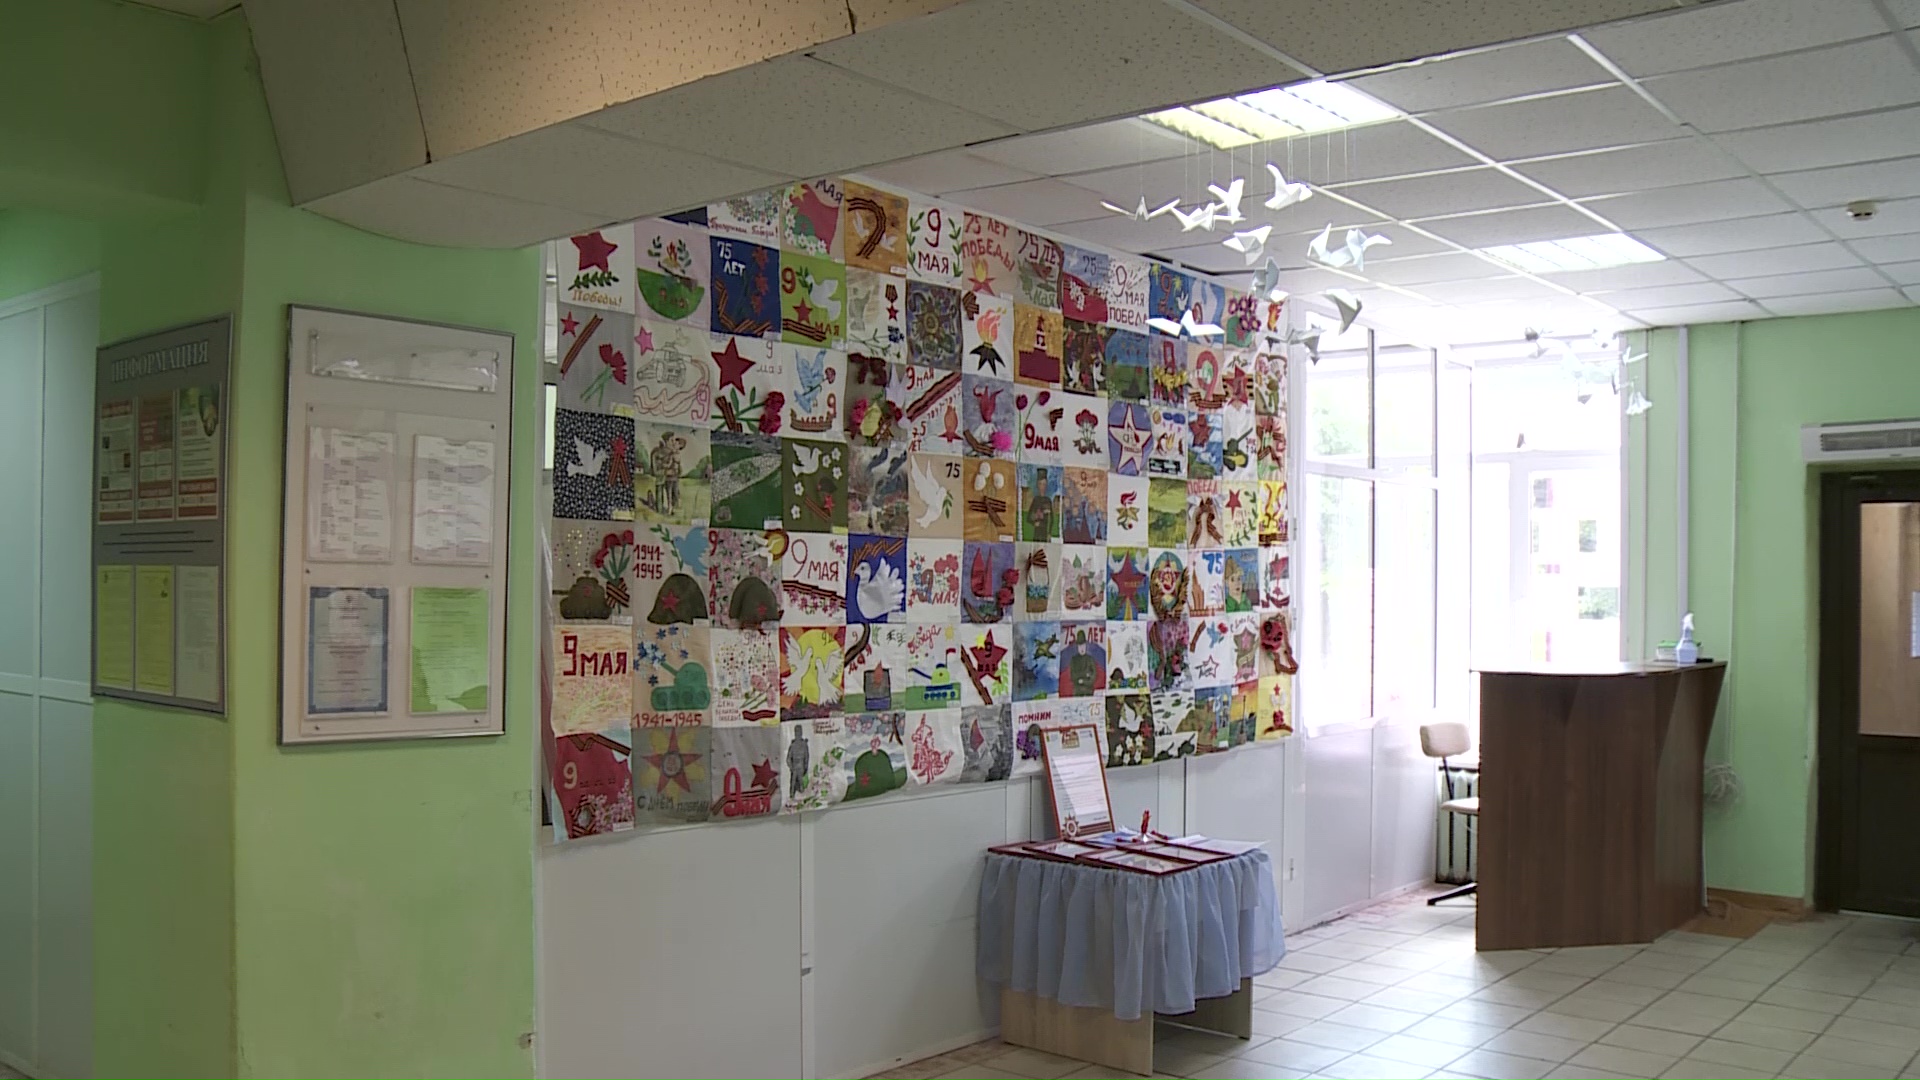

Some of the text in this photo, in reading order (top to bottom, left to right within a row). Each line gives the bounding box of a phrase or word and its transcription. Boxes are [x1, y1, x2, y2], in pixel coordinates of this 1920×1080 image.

[924, 208, 942, 248] 9
[964, 212, 1009, 238] 75 ЛЕТ
[717, 241, 733, 259] 75
[961, 238, 1015, 272] ПОБЕДЫ
[1018, 229, 1039, 260] 75
[723, 260, 746, 278] ЛЕТ
[917, 251, 950, 274] МАЯ
[1082, 255, 1098, 276] 75
[782, 267, 797, 294] 9
[1113, 265, 1128, 298] 9
[1125, 290, 1145, 307] МАЯ
[815, 321, 840, 337] МАЯ
[112, 340, 209, 382] ИНФОРМАЦИЯ
[906, 366, 916, 390] 9
[945, 462, 960, 479] 75
[633, 544, 665, 561] 1941-
[709, 530, 719, 556] 9
[633, 563, 663, 580] 1945
[791, 539, 839, 582] 9 МАЯ
[1202, 552, 1222, 575] 75
[1062, 624, 1106, 645] 75 ЛЕТ
[563, 635, 628, 677] 9 МАЯ
[633, 711, 703, 728] 1941-1945
[563, 762, 578, 790] 9
